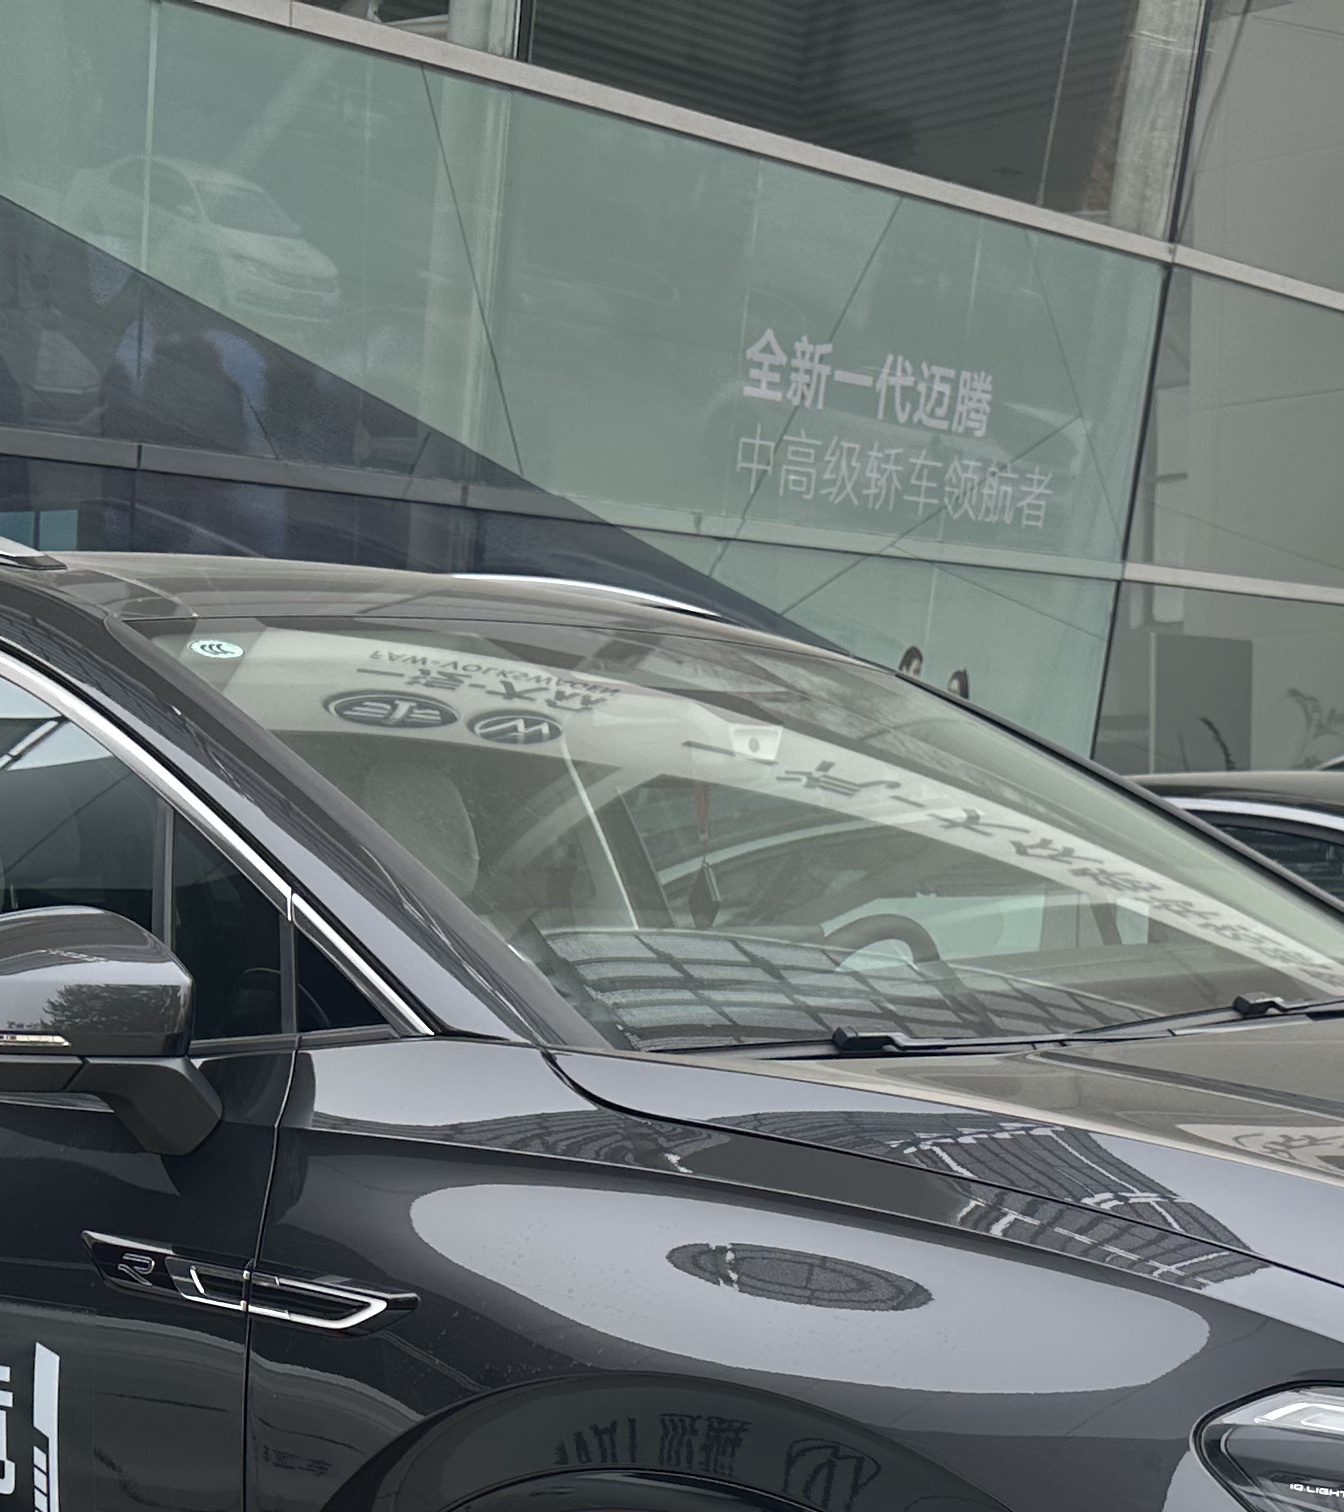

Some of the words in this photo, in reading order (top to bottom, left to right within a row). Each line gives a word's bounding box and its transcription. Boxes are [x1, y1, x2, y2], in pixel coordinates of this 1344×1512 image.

[743, 328, 993, 437] 全新一代迈腾
[736, 423, 1053, 530] 中高级轿车领航者
